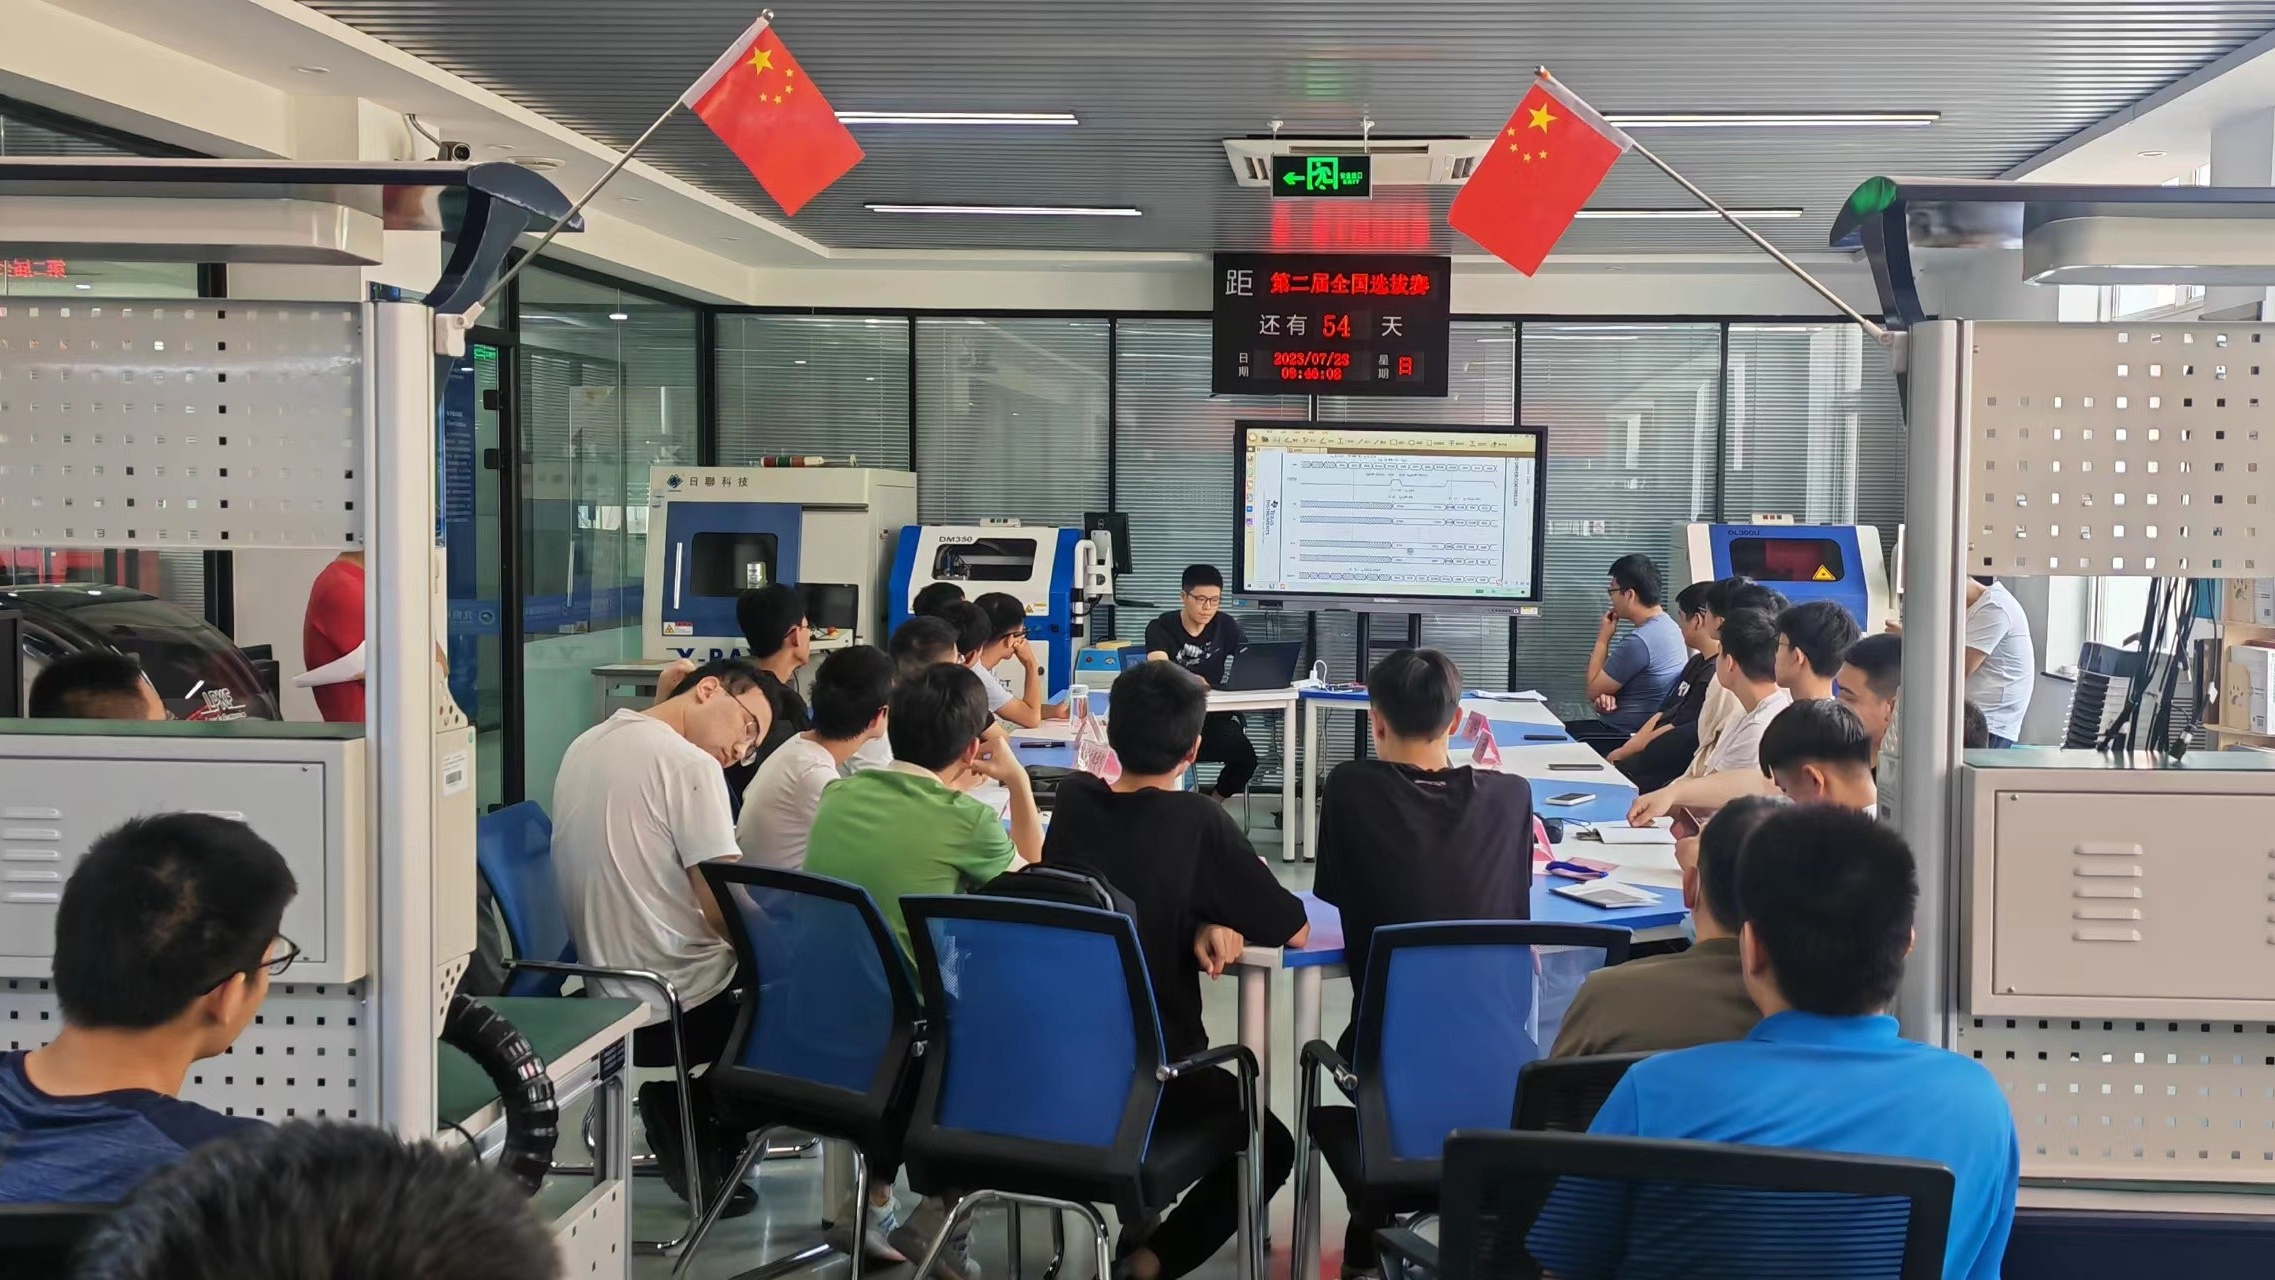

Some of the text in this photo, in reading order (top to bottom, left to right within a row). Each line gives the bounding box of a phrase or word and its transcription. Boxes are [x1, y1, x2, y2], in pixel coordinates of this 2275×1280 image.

[1225, 270, 1430, 296] 距 第二届全国选拔赛
[1259, 314, 1403, 337] 还有 54 天
[1398, 356, 1413, 375] 日
[938, 535, 973, 543] DM350
